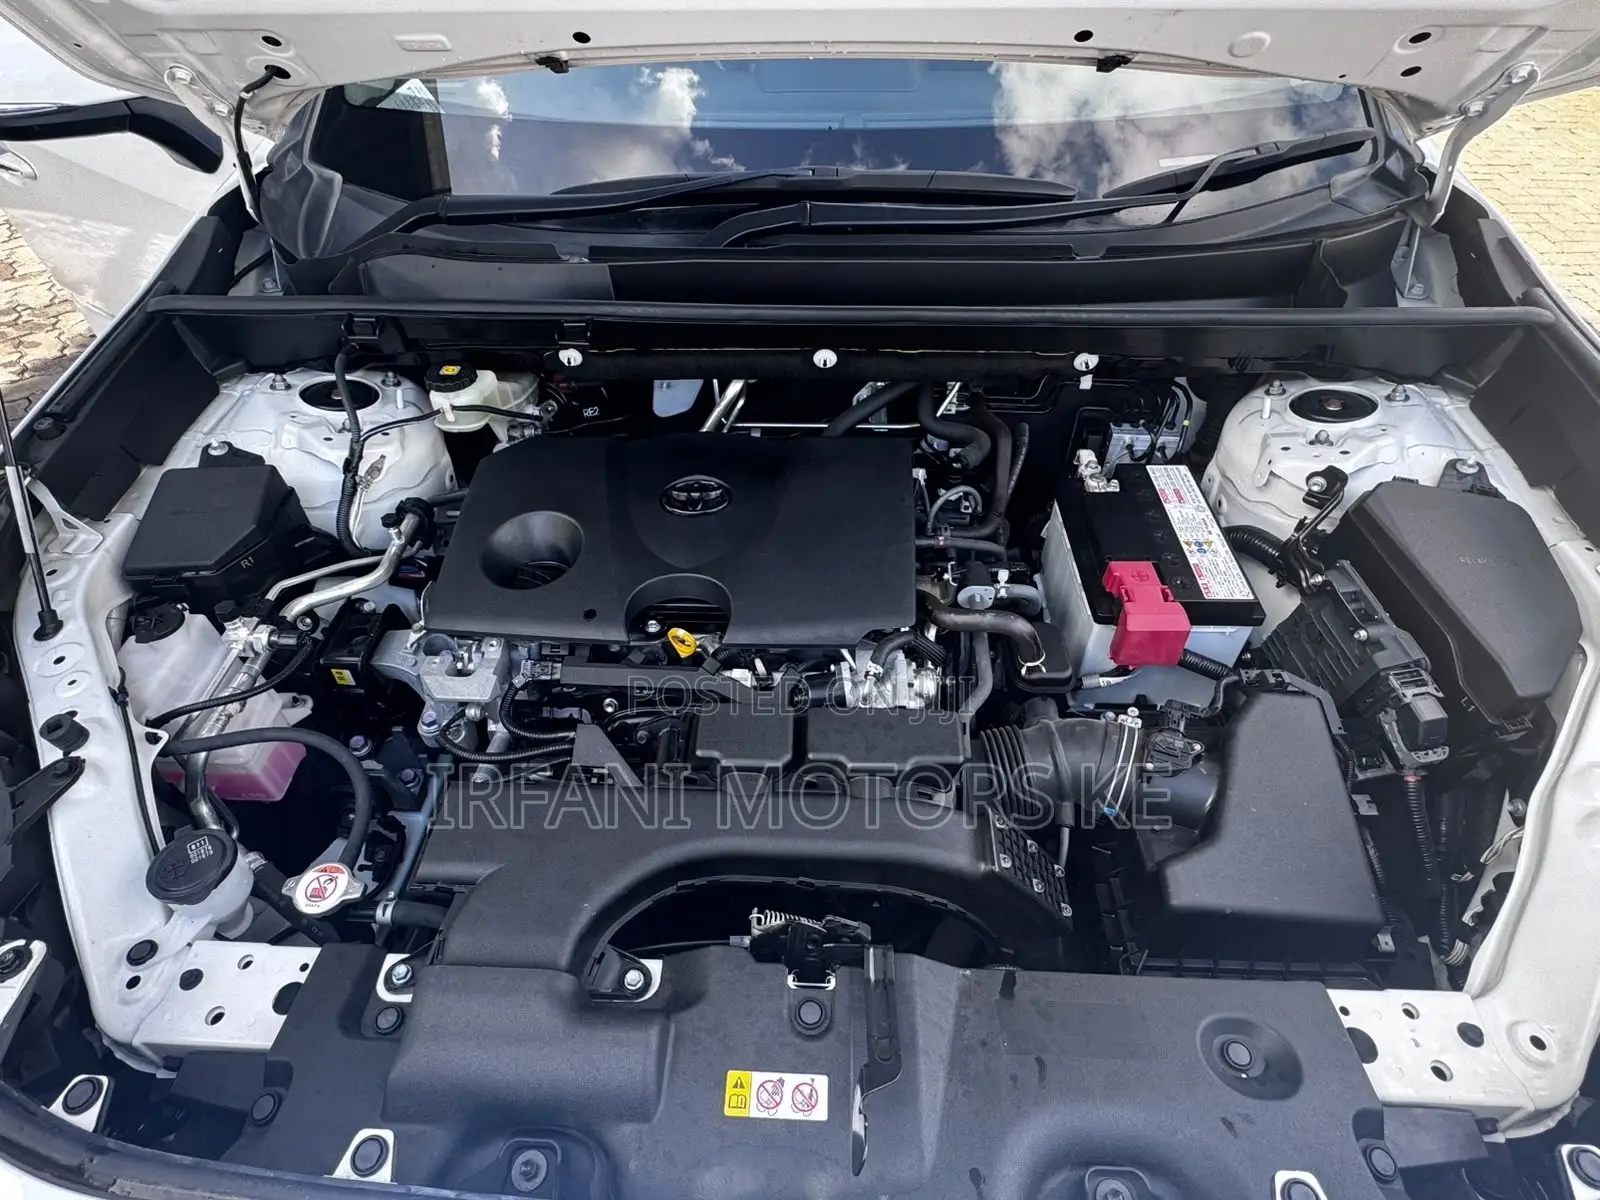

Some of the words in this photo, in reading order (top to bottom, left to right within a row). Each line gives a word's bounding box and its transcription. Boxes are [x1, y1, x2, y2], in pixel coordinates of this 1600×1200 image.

[582, 406, 600, 418] RE2
[240, 556, 255, 569] R1
[1460, 696, 1476, 713] L1
